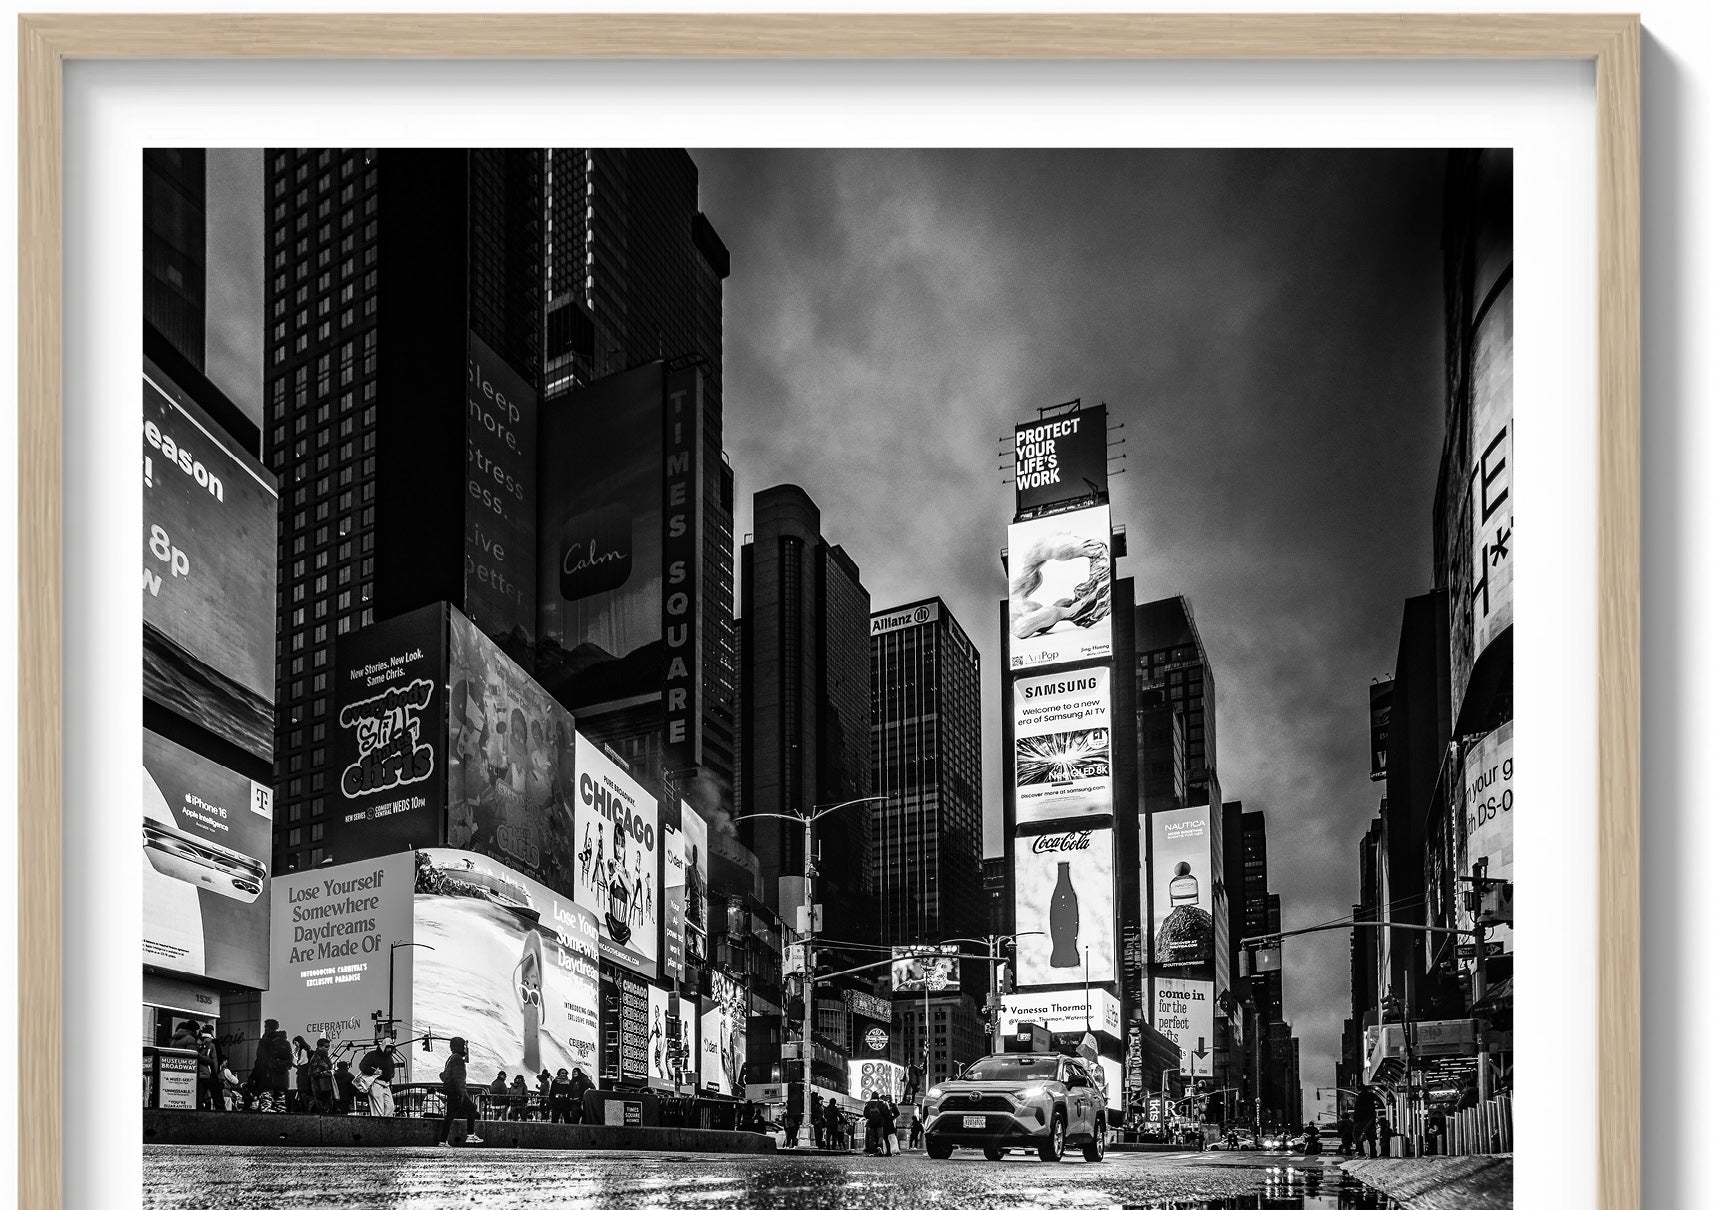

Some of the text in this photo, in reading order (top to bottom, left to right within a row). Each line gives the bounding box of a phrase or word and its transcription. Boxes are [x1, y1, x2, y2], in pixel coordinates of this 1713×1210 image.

[1016, 418, 1081, 446] PROTECT
[1016, 440, 1056, 461] YOUR
[143, 420, 224, 503] eason
[1016, 455, 1058, 476] LIFE'S
[1016, 468, 1061, 491] WORK
[149, 524, 189, 578] 8p
[564, 539, 628, 576] Calm
[667, 390, 688, 745] TIMES SQUARE
[872, 614, 912, 632] Allianz
[350, 648, 424, 681] New Stories. New Look.
[367, 667, 406, 687] Same Chris.
[1026, 678, 1097, 698] SAMSUNG
[1018, 718, 1032, 726] era
[1044, 712, 1083, 722] Samsung
[1022, 704, 1061, 715] Welcome
[1096, 766, 1108, 775] 8K
[604, 775, 614, 789] PURE
[1067, 785, 1106, 793] samsung.com
[1472, 766, 1499, 802] your
[192, 795, 228, 819] iPhone 16
[345, 796, 426, 823] NEW SERIES COMEDY WEDS 10PM
[375, 808, 392, 818] CENTRAL
[580, 773, 654, 852] CHICAGO
[182, 806, 199, 819] Apple
[199, 814, 229, 832] Intelligence
[1165, 820, 1206, 830] NAUTICA
[1033, 830, 1094, 854] Coca-Cola
[289, 870, 384, 903] Lose Yourself
[292, 896, 379, 922] Somewhere
[553, 900, 576, 929] Lose
[294, 918, 376, 944] Daydreams
[666, 928, 684, 943] poweed
[290, 934, 382, 963] Are Made Of
[300, 963, 368, 978] INTRODUCING CARNIVAL'S
[668, 958, 682, 971] planer
[306, 974, 361, 987] EXCLUSIVE PARADISE
[623, 980, 648, 999] CHICAGO
[1159, 989, 1205, 1000] come in
[1011, 1004, 1092, 1015] Vanessa Thorman
[1159, 999, 1187, 1014] for the
[306, 1019, 361, 1033] CELEBRATION
[1009, 1015, 1094, 1025] @Vanessa_Thorman_Watercoor
[1158, 1015, 1189, 1032] perfect
[326, 1030, 341, 1041] KEY
[1161, 1030, 1179, 1044] ifts
[1150, 1099, 1160, 1122] tkts
